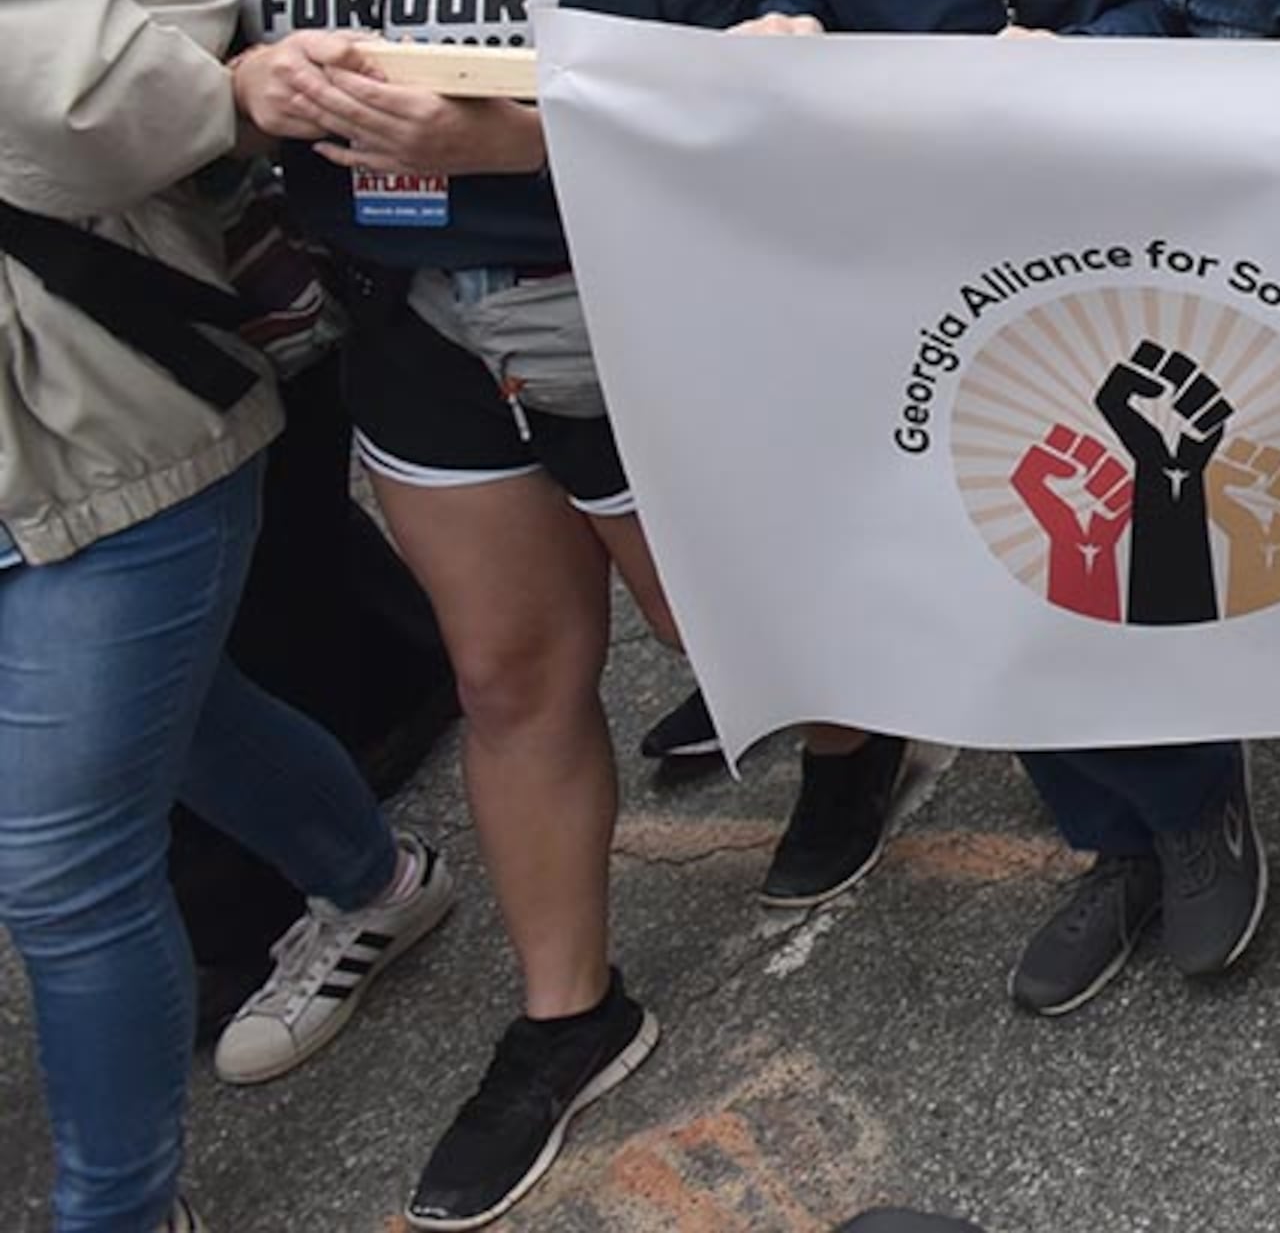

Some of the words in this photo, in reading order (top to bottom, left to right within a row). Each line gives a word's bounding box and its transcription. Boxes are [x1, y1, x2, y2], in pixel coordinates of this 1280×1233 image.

[894, 313, 968, 455] Georgia
[959, 243, 1133, 321] Alliance
[1145, 240, 1219, 278] for
